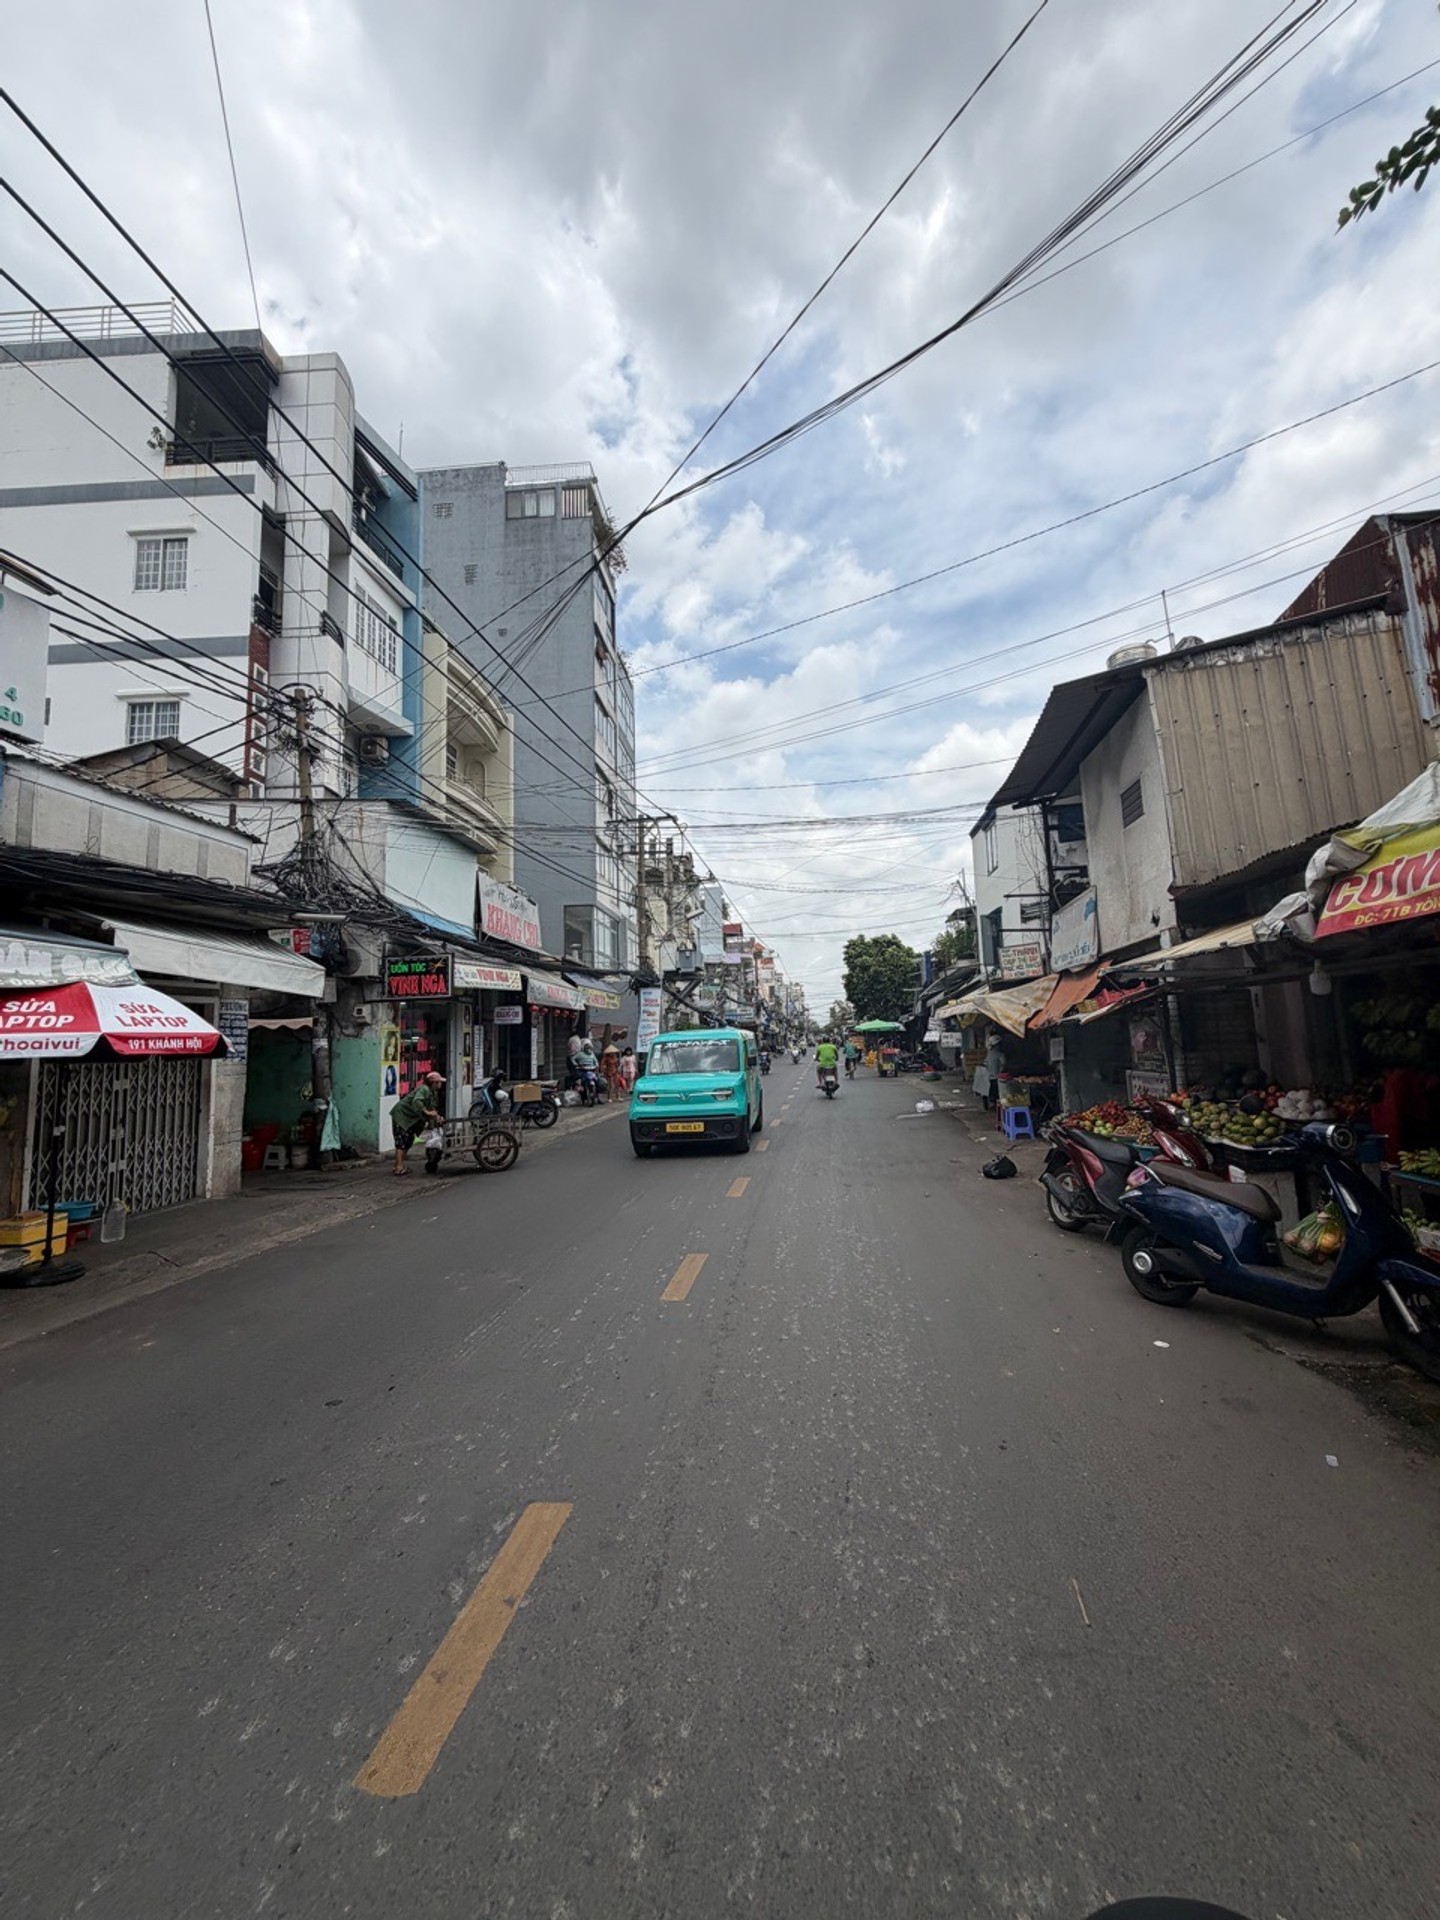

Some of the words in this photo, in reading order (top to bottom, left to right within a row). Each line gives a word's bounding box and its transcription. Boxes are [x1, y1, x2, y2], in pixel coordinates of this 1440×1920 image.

[389, 976, 419, 995] VINH
[421, 974, 447, 993] NGA
[115, 1015, 188, 1028] LAPTOP
[127, 1040, 145, 1051] 191
[148, 1036, 184, 1050] KHÁNH
[186, 1037, 202, 1051] HỘI
